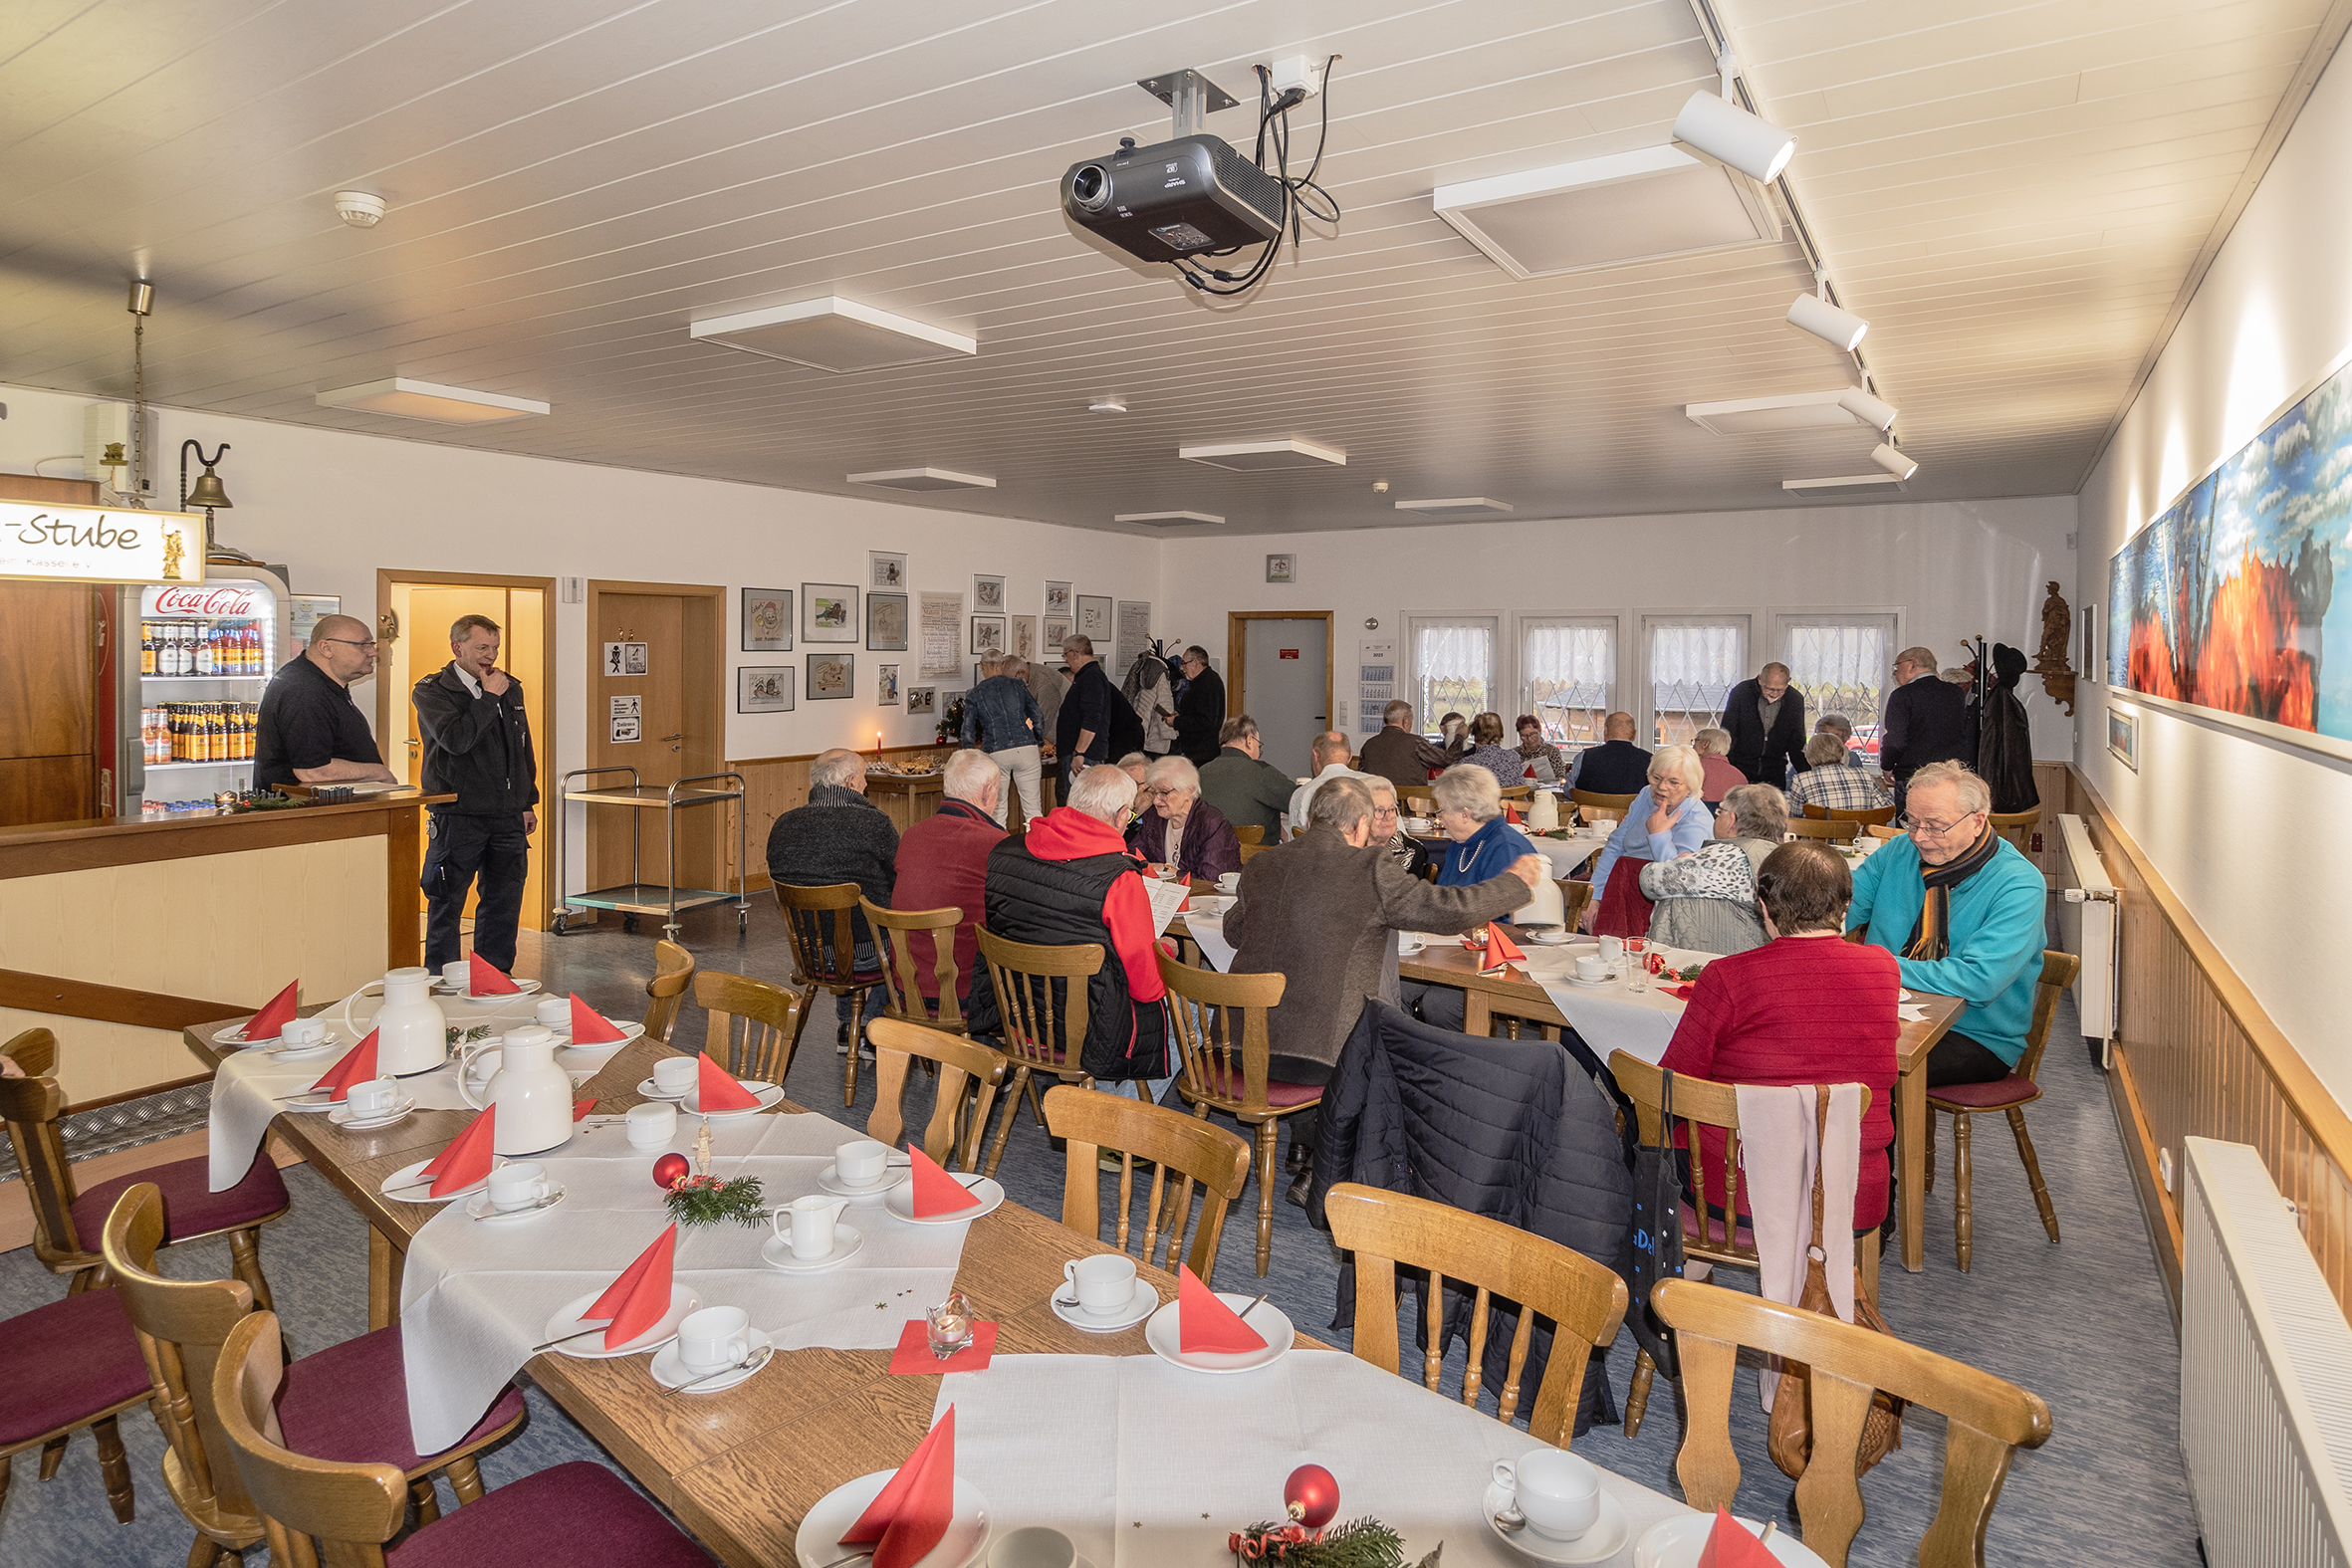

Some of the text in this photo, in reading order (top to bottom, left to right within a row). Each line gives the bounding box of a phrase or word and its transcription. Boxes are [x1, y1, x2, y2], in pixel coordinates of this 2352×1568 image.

[1164, 179, 1186, 188] SHARP
[0, 514, 141, 550] -Stube
[155, 586, 255, 615] Coca-Cola
